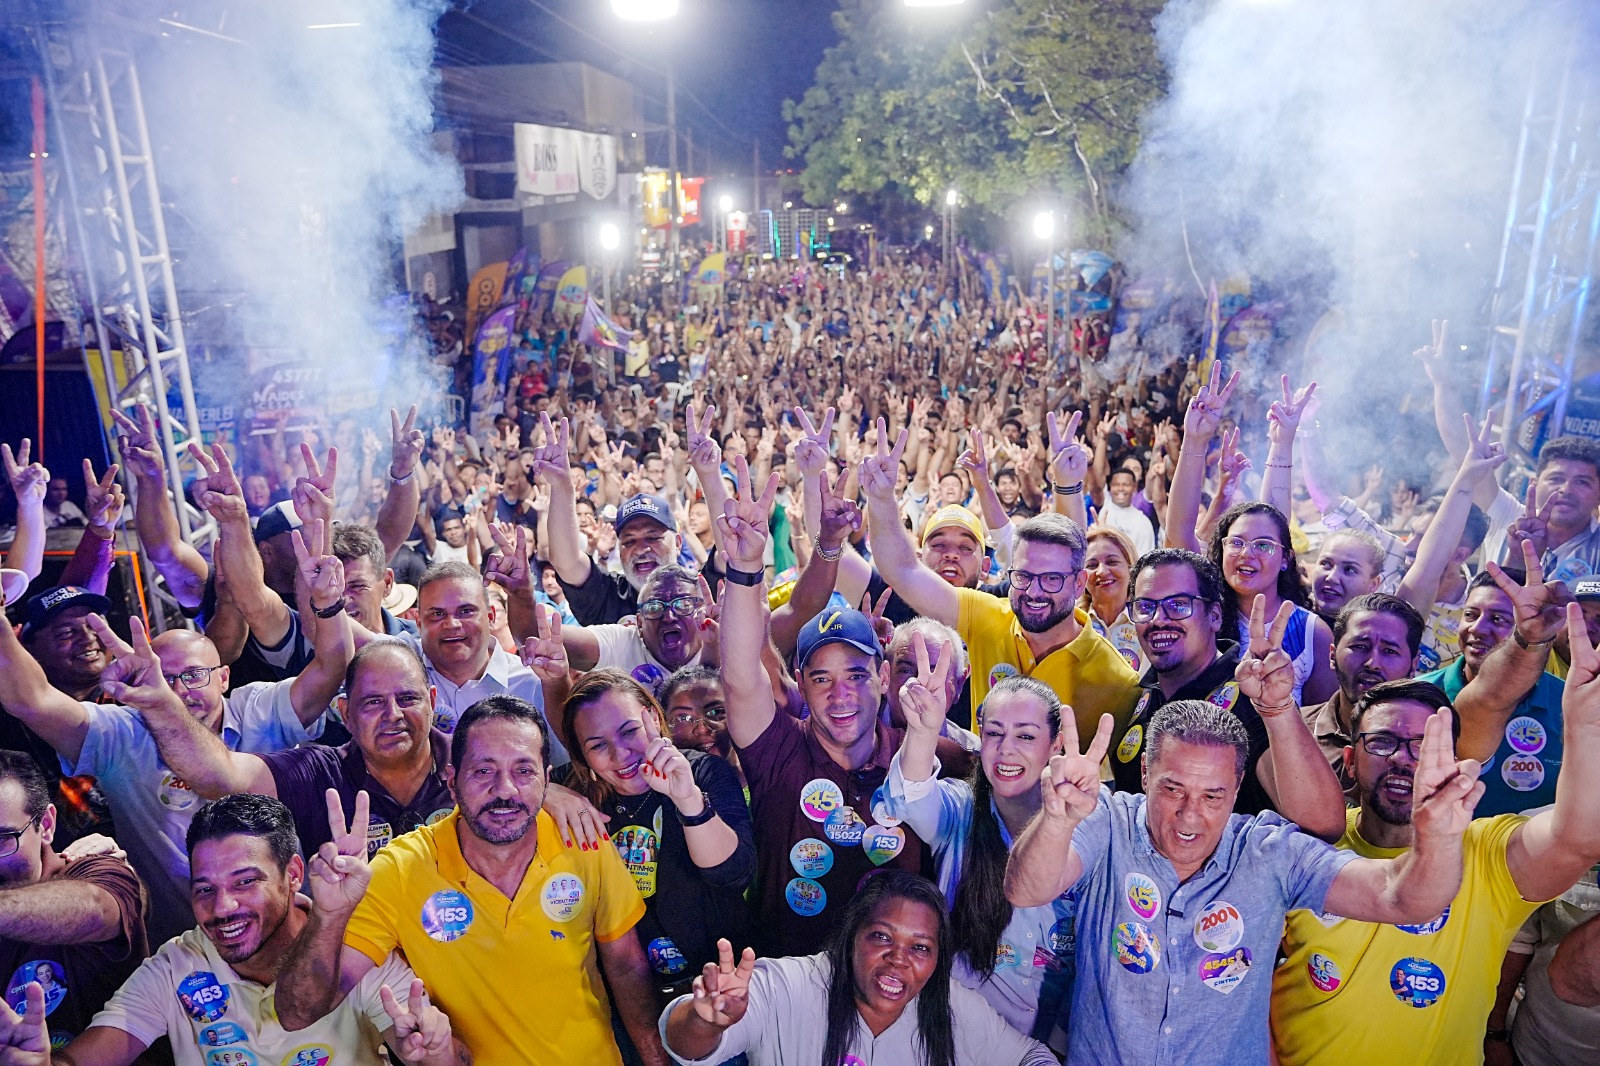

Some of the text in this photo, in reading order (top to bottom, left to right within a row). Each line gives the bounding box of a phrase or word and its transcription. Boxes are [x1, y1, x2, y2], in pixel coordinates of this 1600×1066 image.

[1511, 727, 1540, 746] 45
[1511, 761, 1535, 772] 200
[804, 789, 837, 811] 45
[830, 831, 862, 840] 15022
[874, 836, 898, 849] 153
[1128, 884, 1153, 911] 45
[436, 907, 467, 922] 153
[1201, 908, 1228, 931] 200
[1052, 940, 1077, 951] 1502
[1116, 942, 1147, 969] SENADOR
[1204, 957, 1236, 970] 4545
[1313, 968, 1330, 983] 45
[1406, 974, 1440, 992] 153
[192, 985, 223, 1005] 153
